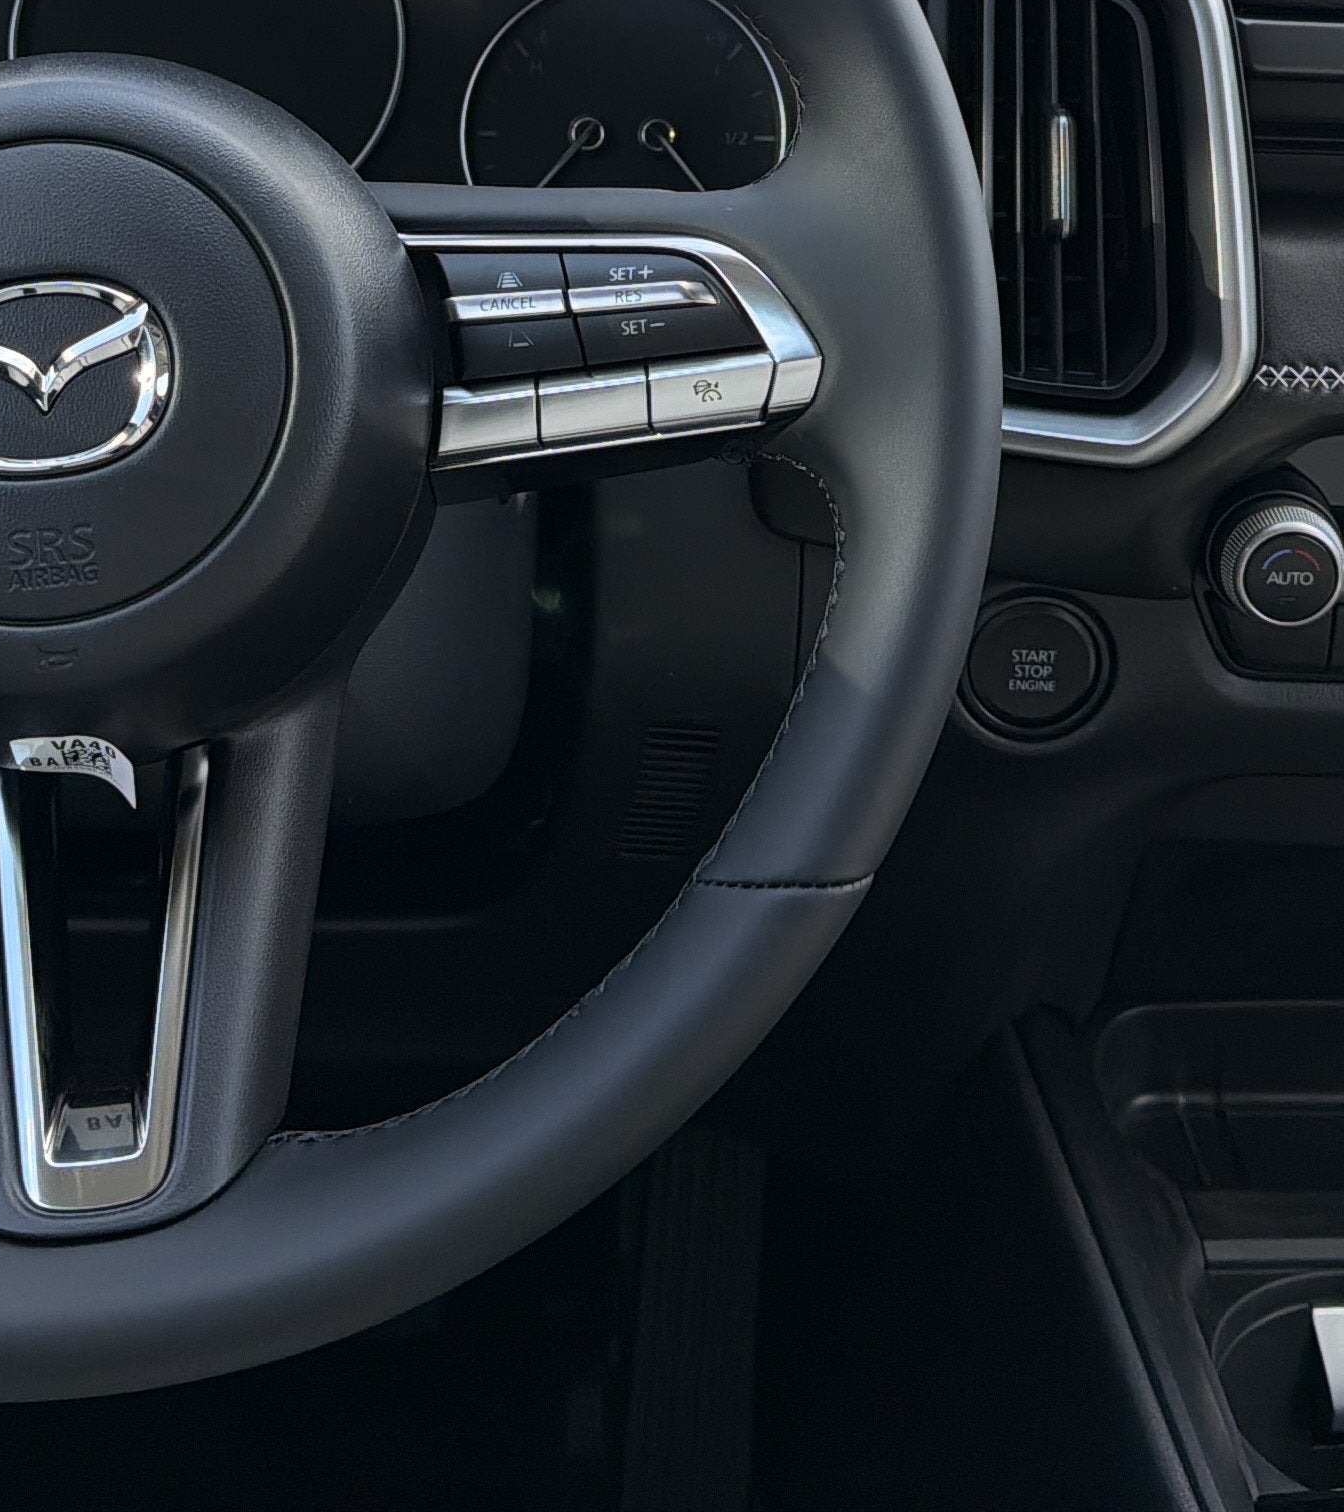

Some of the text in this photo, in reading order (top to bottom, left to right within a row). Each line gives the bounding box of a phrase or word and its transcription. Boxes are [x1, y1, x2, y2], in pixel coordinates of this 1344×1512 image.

[615, 289, 643, 304] RES
[479, 296, 537, 313] CANCEL
[7, 524, 96, 570] SRS
[9, 567, 98, 592] AIRBAG
[1266, 571, 1314, 587] AUTO
[1011, 649, 1057, 664] START
[1014, 665, 1053, 679] STOP
[1009, 679, 1056, 692] ENGINE
